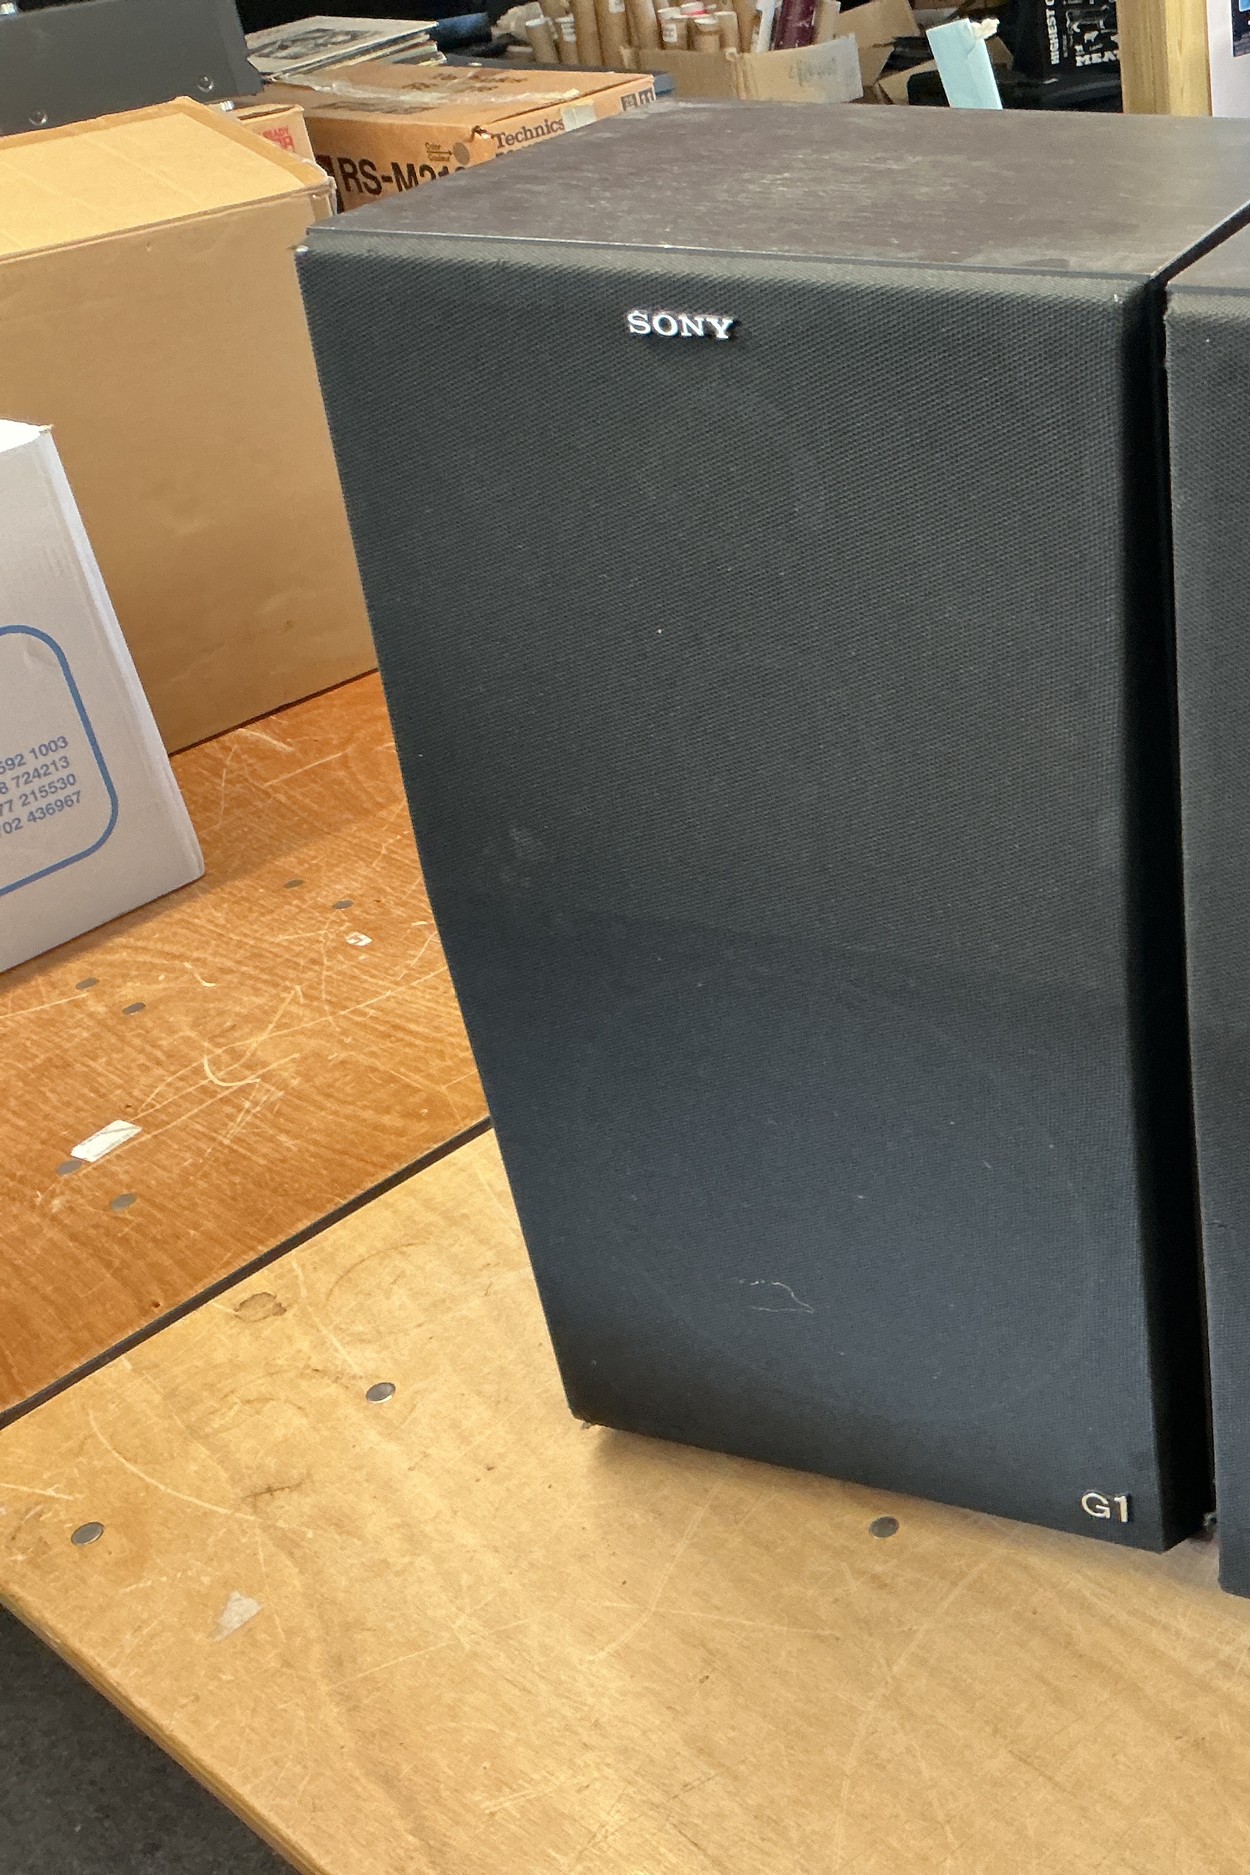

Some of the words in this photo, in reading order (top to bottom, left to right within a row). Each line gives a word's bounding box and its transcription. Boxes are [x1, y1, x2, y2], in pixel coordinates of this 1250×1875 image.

[493, 118, 566, 149] Technics
[627, 310, 734, 339] SONY
[29, 736, 69, 760] 1003
[11, 756, 71, 788] 724213
[19, 773, 77, 807] 215530
[0, 817, 24, 835] 02
[27, 790, 82, 823] 436967
[1082, 1492, 1128, 1523] G1
